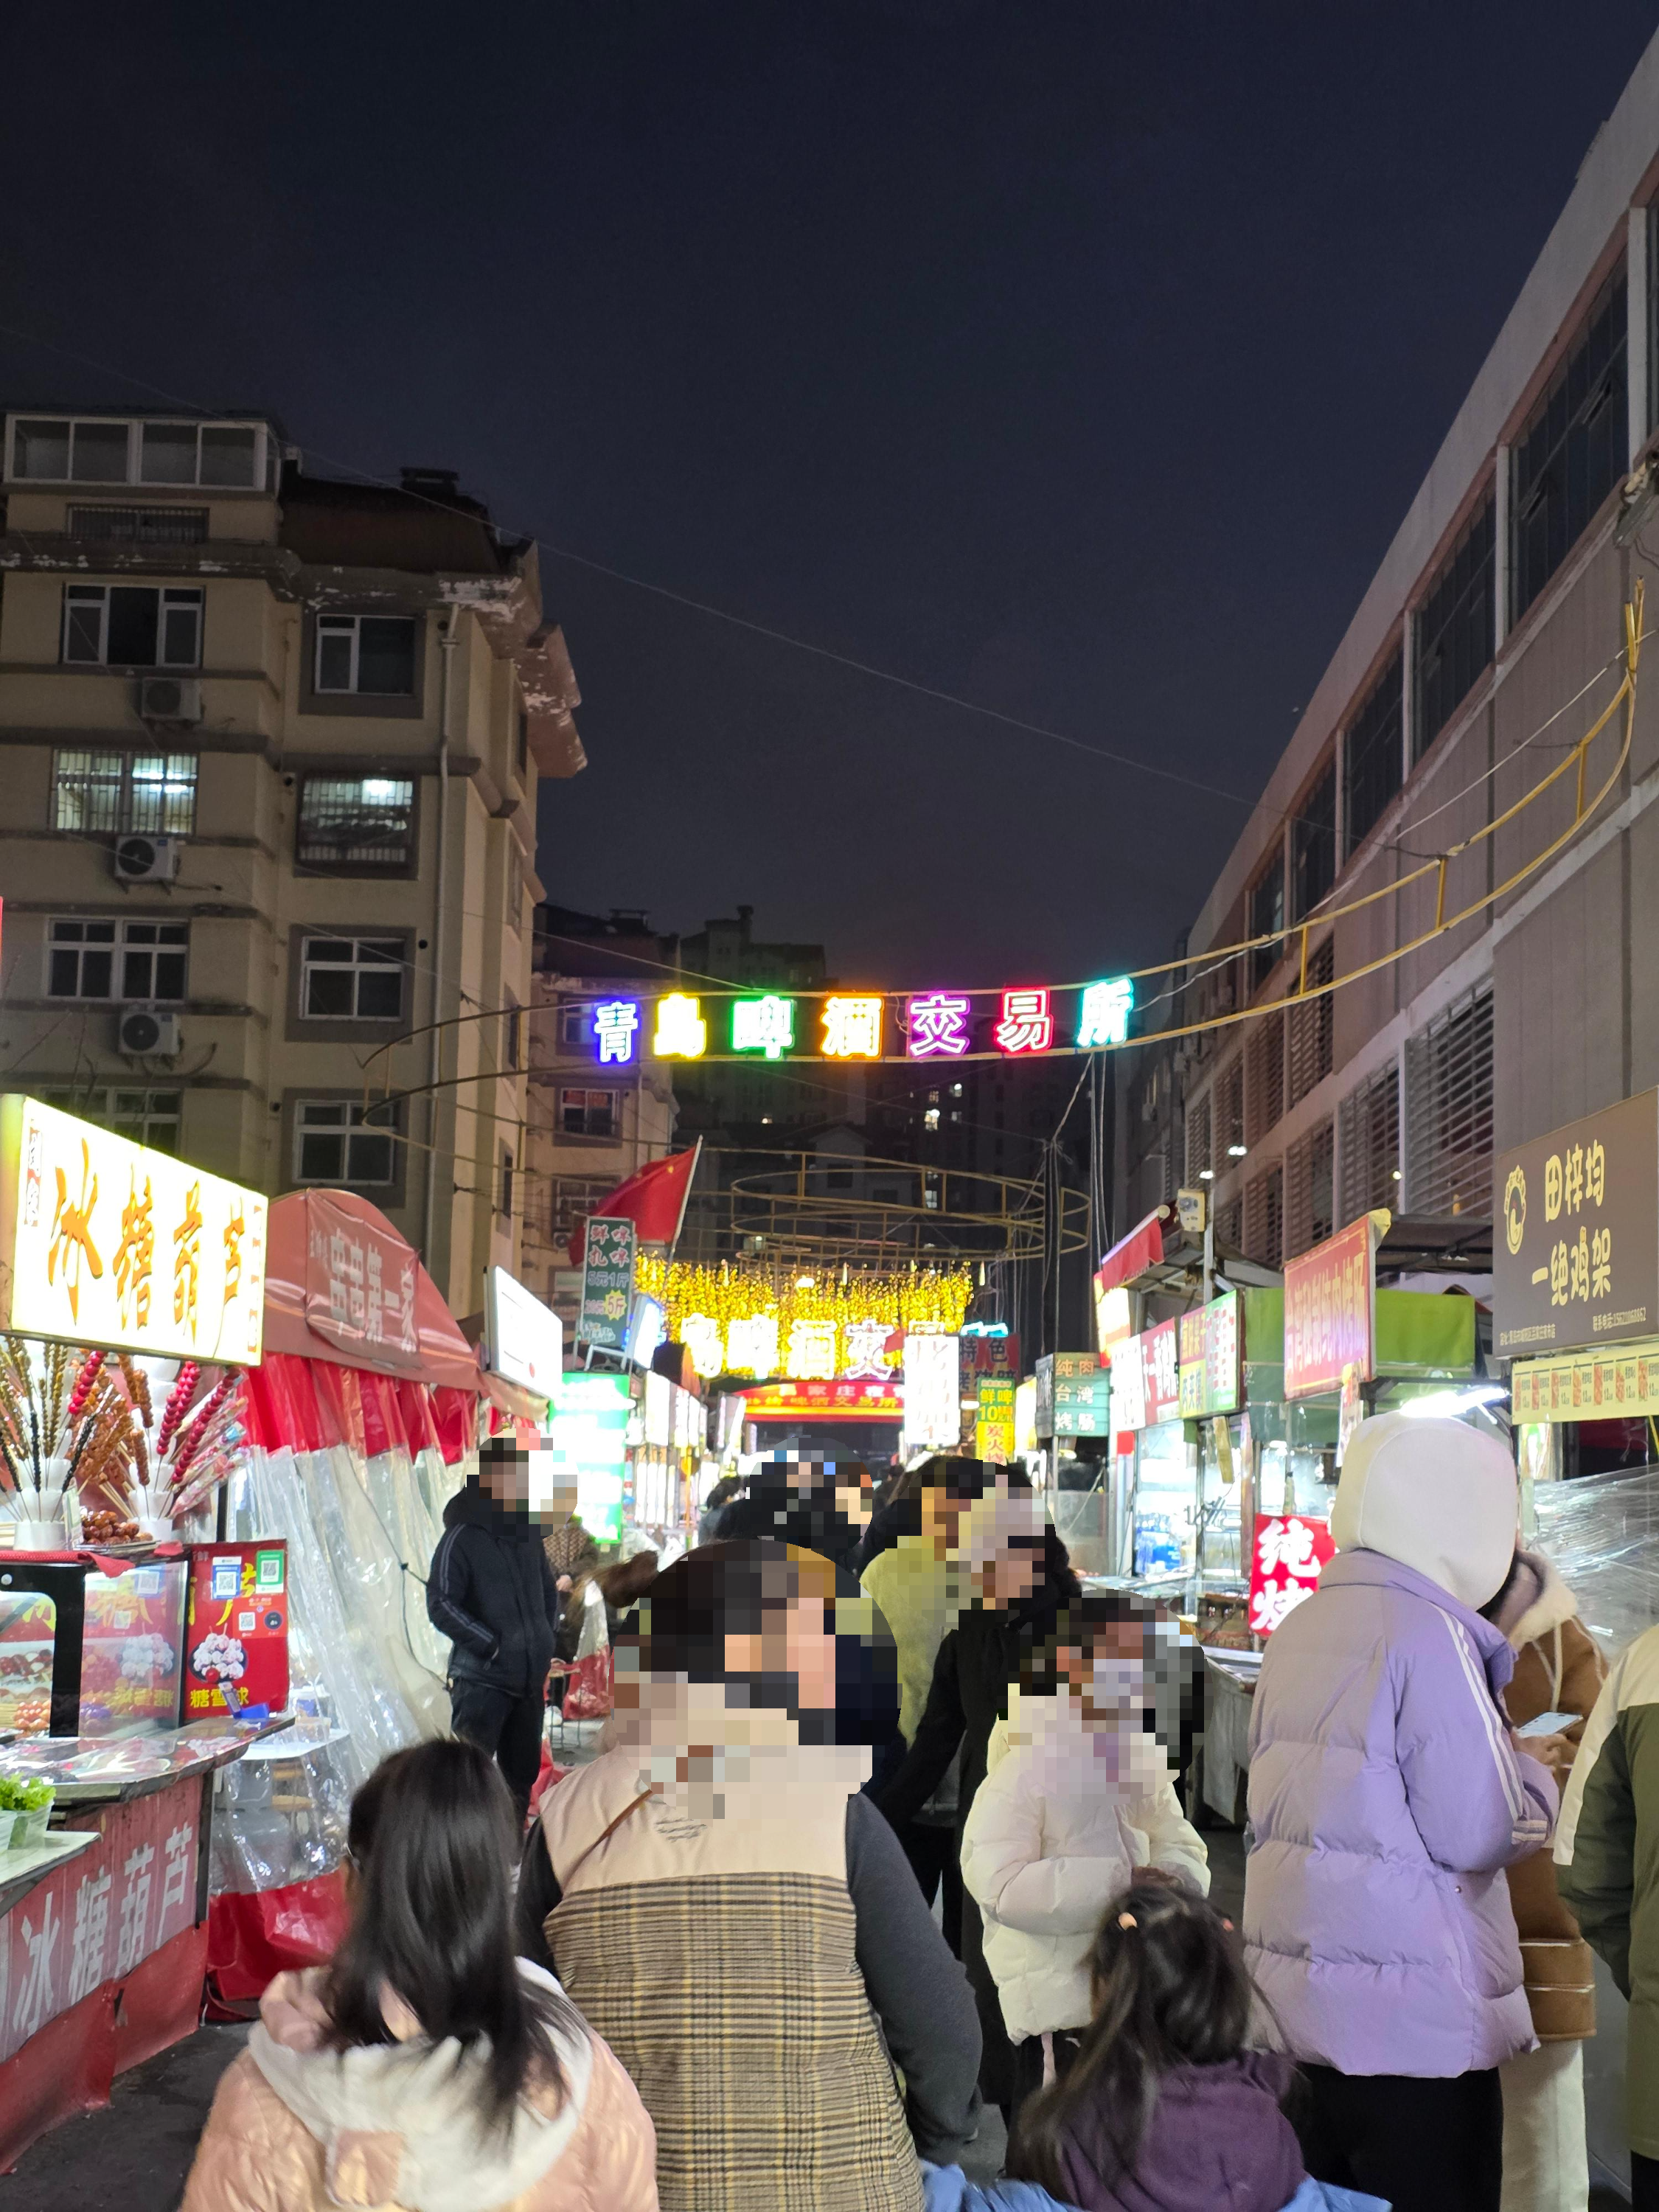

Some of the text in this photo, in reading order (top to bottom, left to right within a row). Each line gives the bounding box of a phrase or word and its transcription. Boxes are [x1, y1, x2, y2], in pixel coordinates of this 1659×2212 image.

[593, 975, 1136, 1063] 青岛啤酒交易所
[1544, 1139, 1605, 1223] 田梓均
[47, 1137, 246, 1359] 冰糖葫芦
[1531, 1226, 1612, 1307] 一绝鸡架
[980, 1388, 1013, 1405] 鲜啤
[1055, 1359, 1094, 1377] 纯肉
[1055, 1383, 1094, 1404] 台湾
[1054, 1411, 1096, 1431] 烤肠
[13, 1821, 193, 2037] 冰糖葫芦
